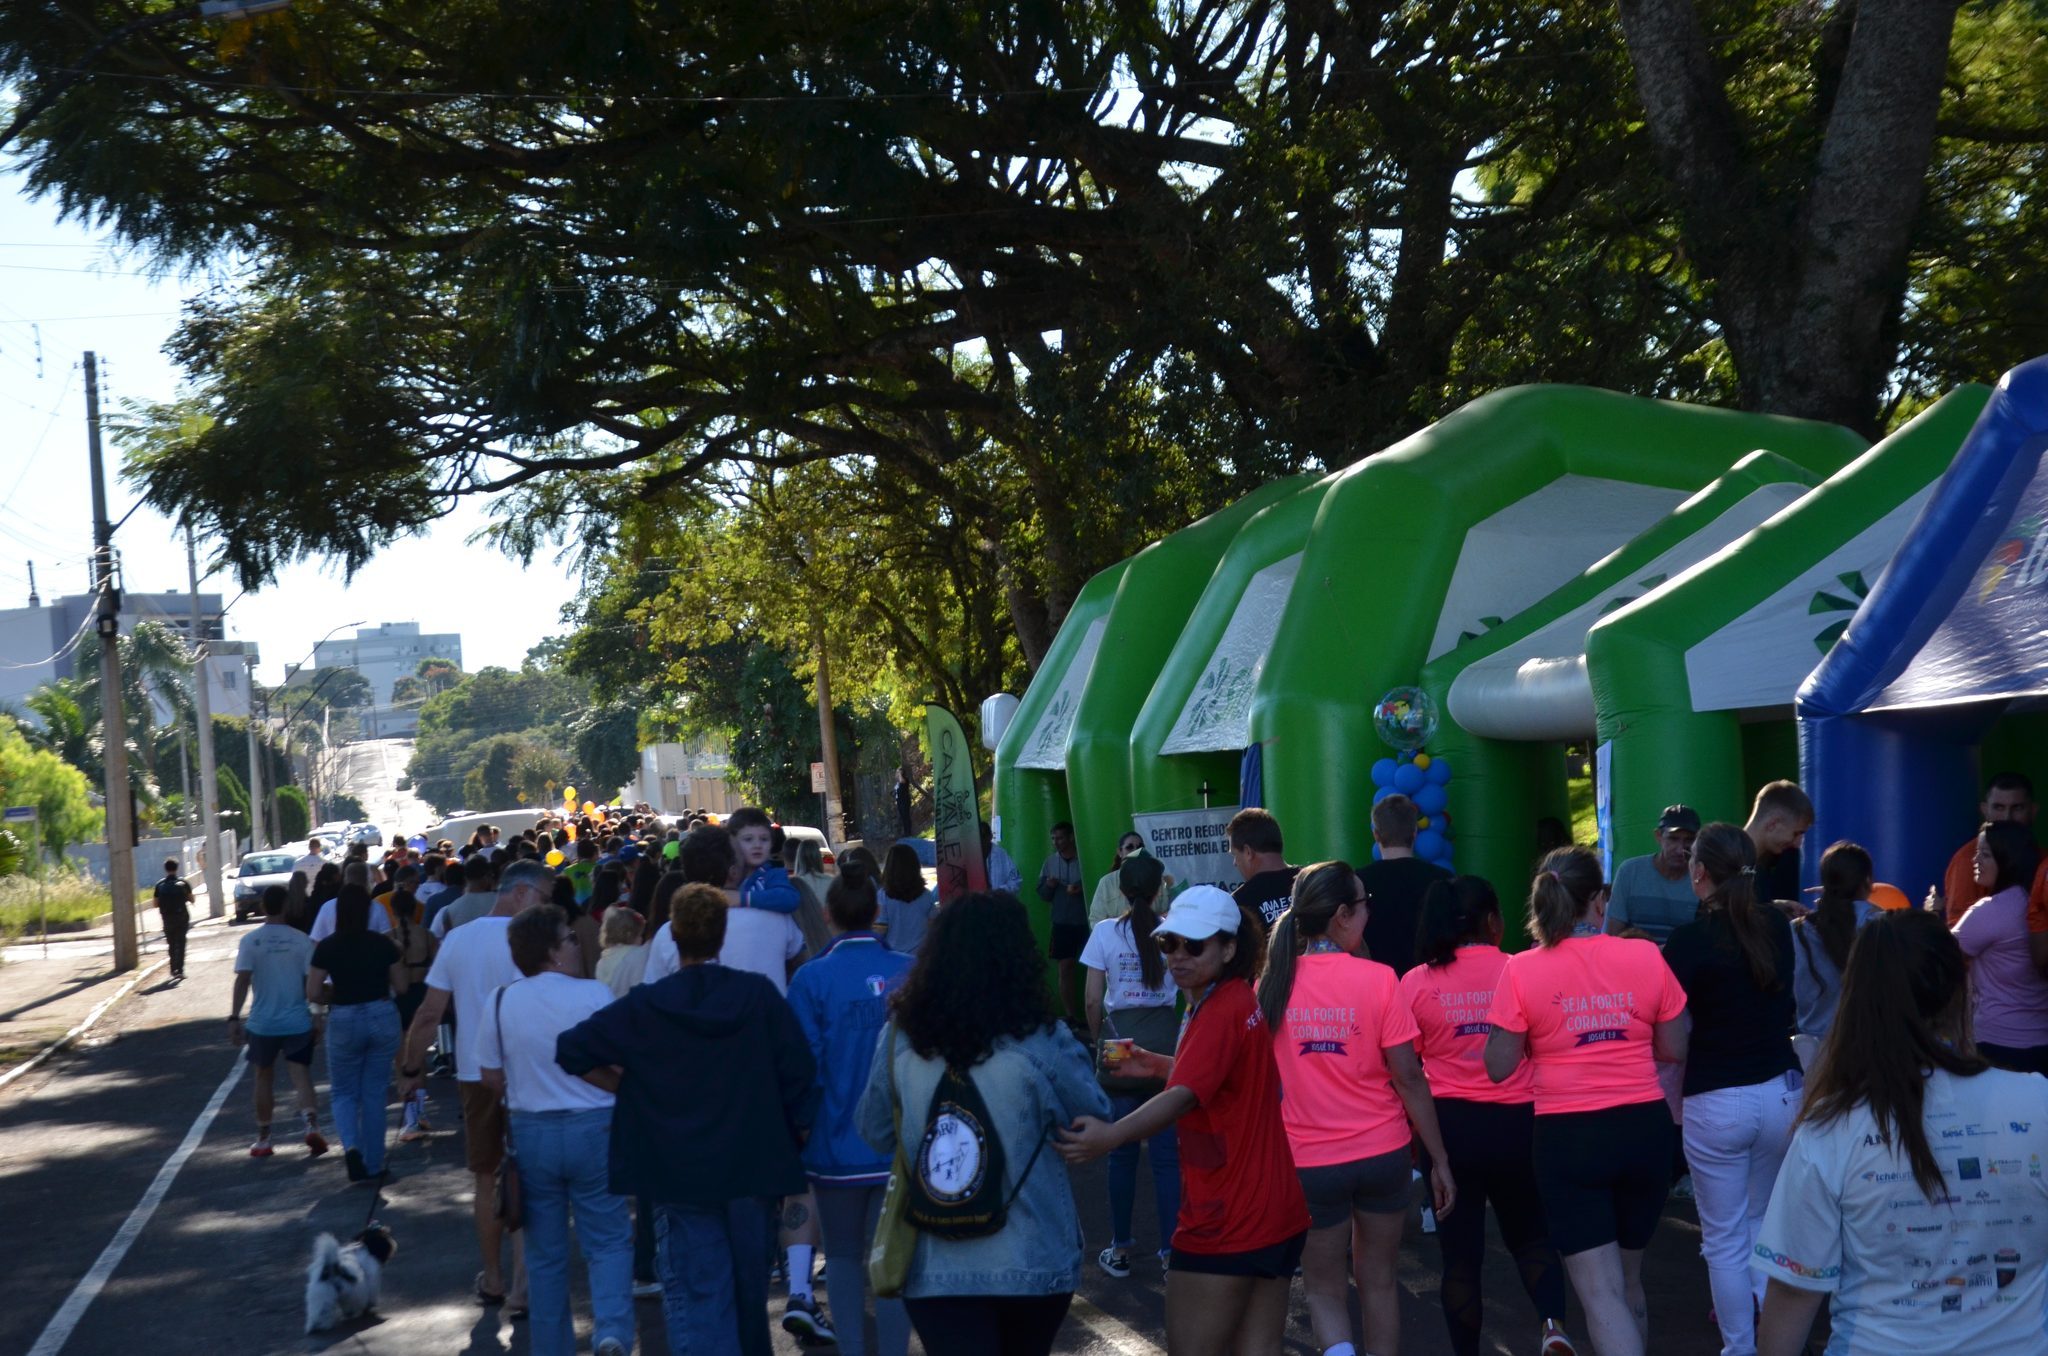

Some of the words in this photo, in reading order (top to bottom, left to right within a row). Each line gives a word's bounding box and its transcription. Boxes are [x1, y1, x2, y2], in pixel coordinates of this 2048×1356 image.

[1151, 826, 1192, 842] CENTRO
[1195, 823, 1229, 838] REGIO
[1155, 841, 1219, 858] REFERÊNCIA
[1221, 842, 1230, 853] E
[1123, 990, 1140, 998] Casa
[1141, 990, 1166, 998] Branca
[1440, 993, 1465, 1007] SEJA
[1561, 997, 1588, 1012] SEJA
[1591, 993, 1625, 1010] FORTE
[1627, 992, 1634, 1007] E
[1286, 1008, 1311, 1022] SEJA
[1313, 1008, 1346, 1022] FORTE
[1349, 1008, 1356, 1022] E
[1566, 1011, 1631, 1032] CORAJOSA!
[1292, 1025, 1350, 1039] CORAJOSA!
[1588, 1031, 1606, 1042] JOSUÉ
